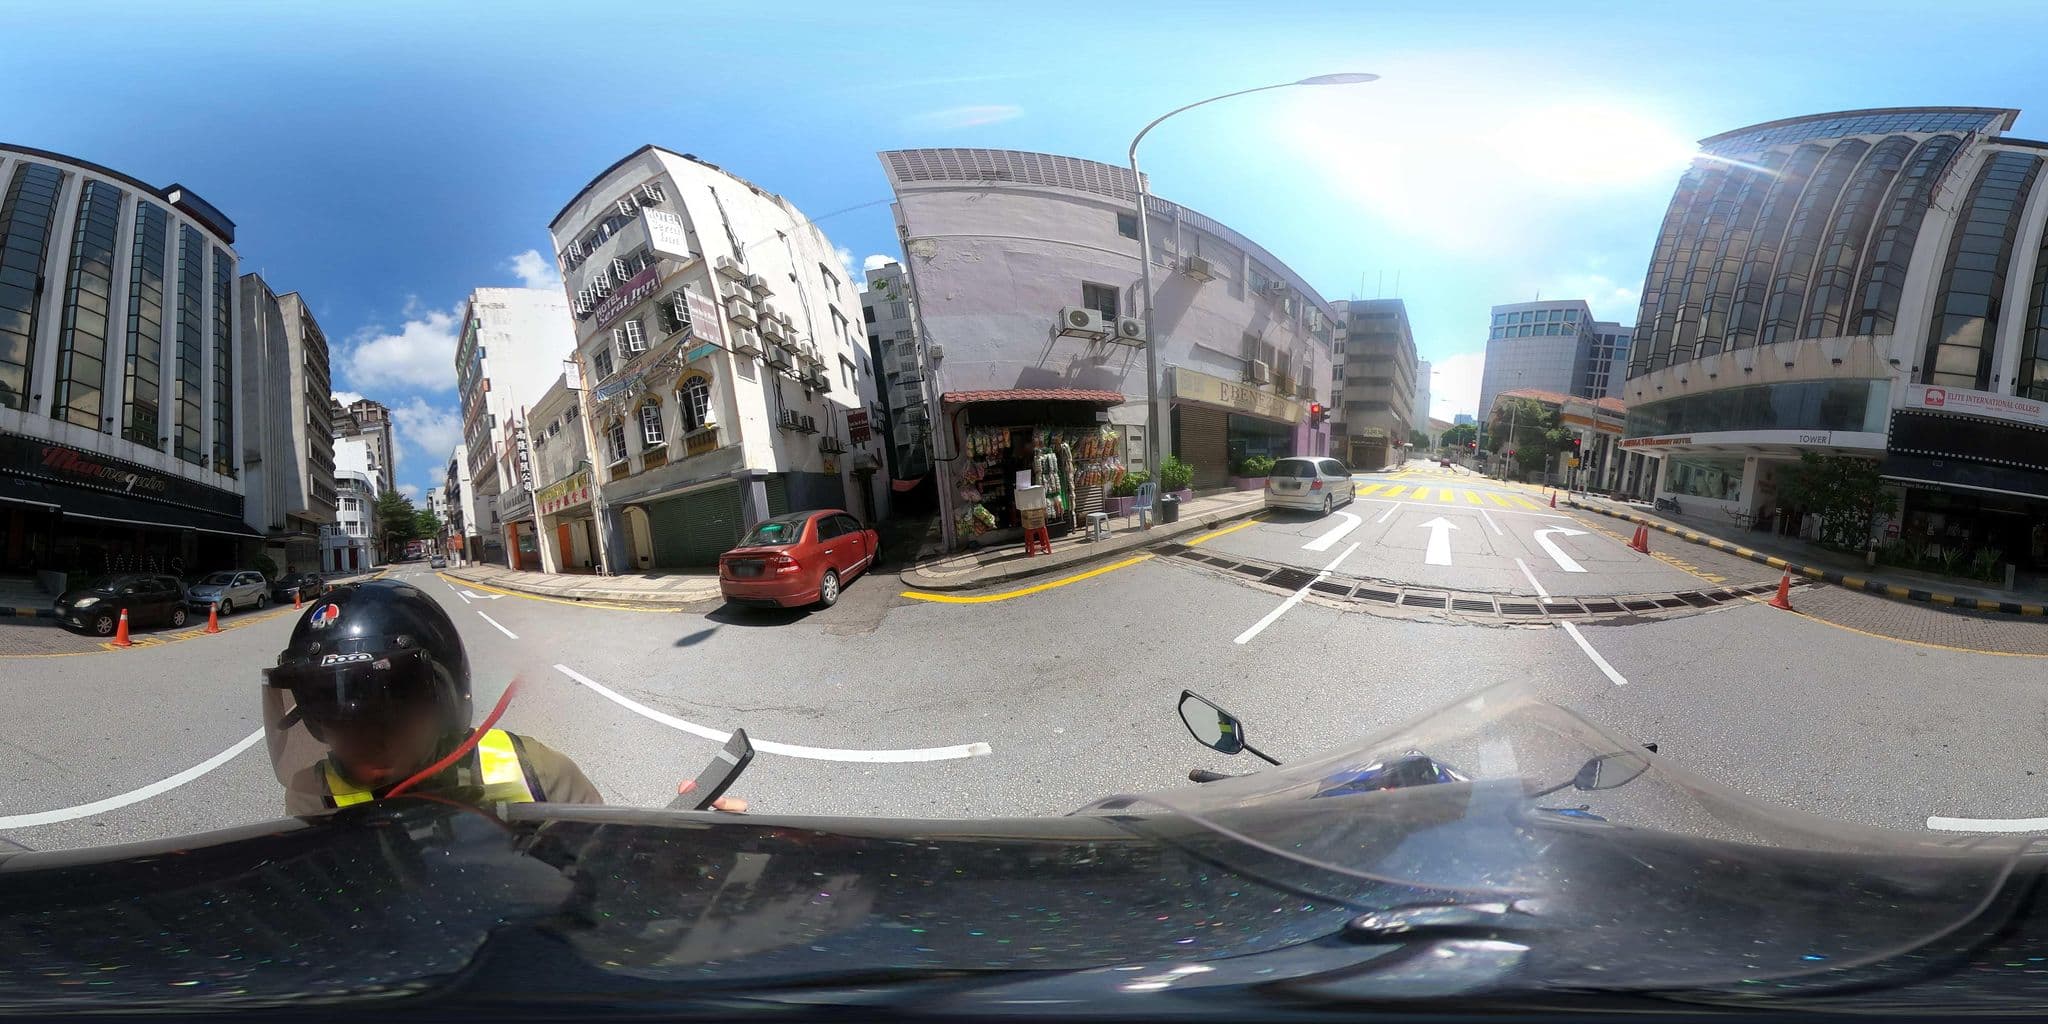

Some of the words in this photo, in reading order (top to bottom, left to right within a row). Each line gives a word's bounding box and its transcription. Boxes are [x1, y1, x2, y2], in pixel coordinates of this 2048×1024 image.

[596, 293, 621, 318] HOTEL
[599, 296, 629, 326] Serai
[632, 278, 657, 300] Inn
[1947, 392, 1964, 401] ELITE
[1966, 395, 2013, 408] INTERNATIONAL
[2014, 402, 2041, 414] COLLEGE
[1799, 435, 1827, 444] TOWER
